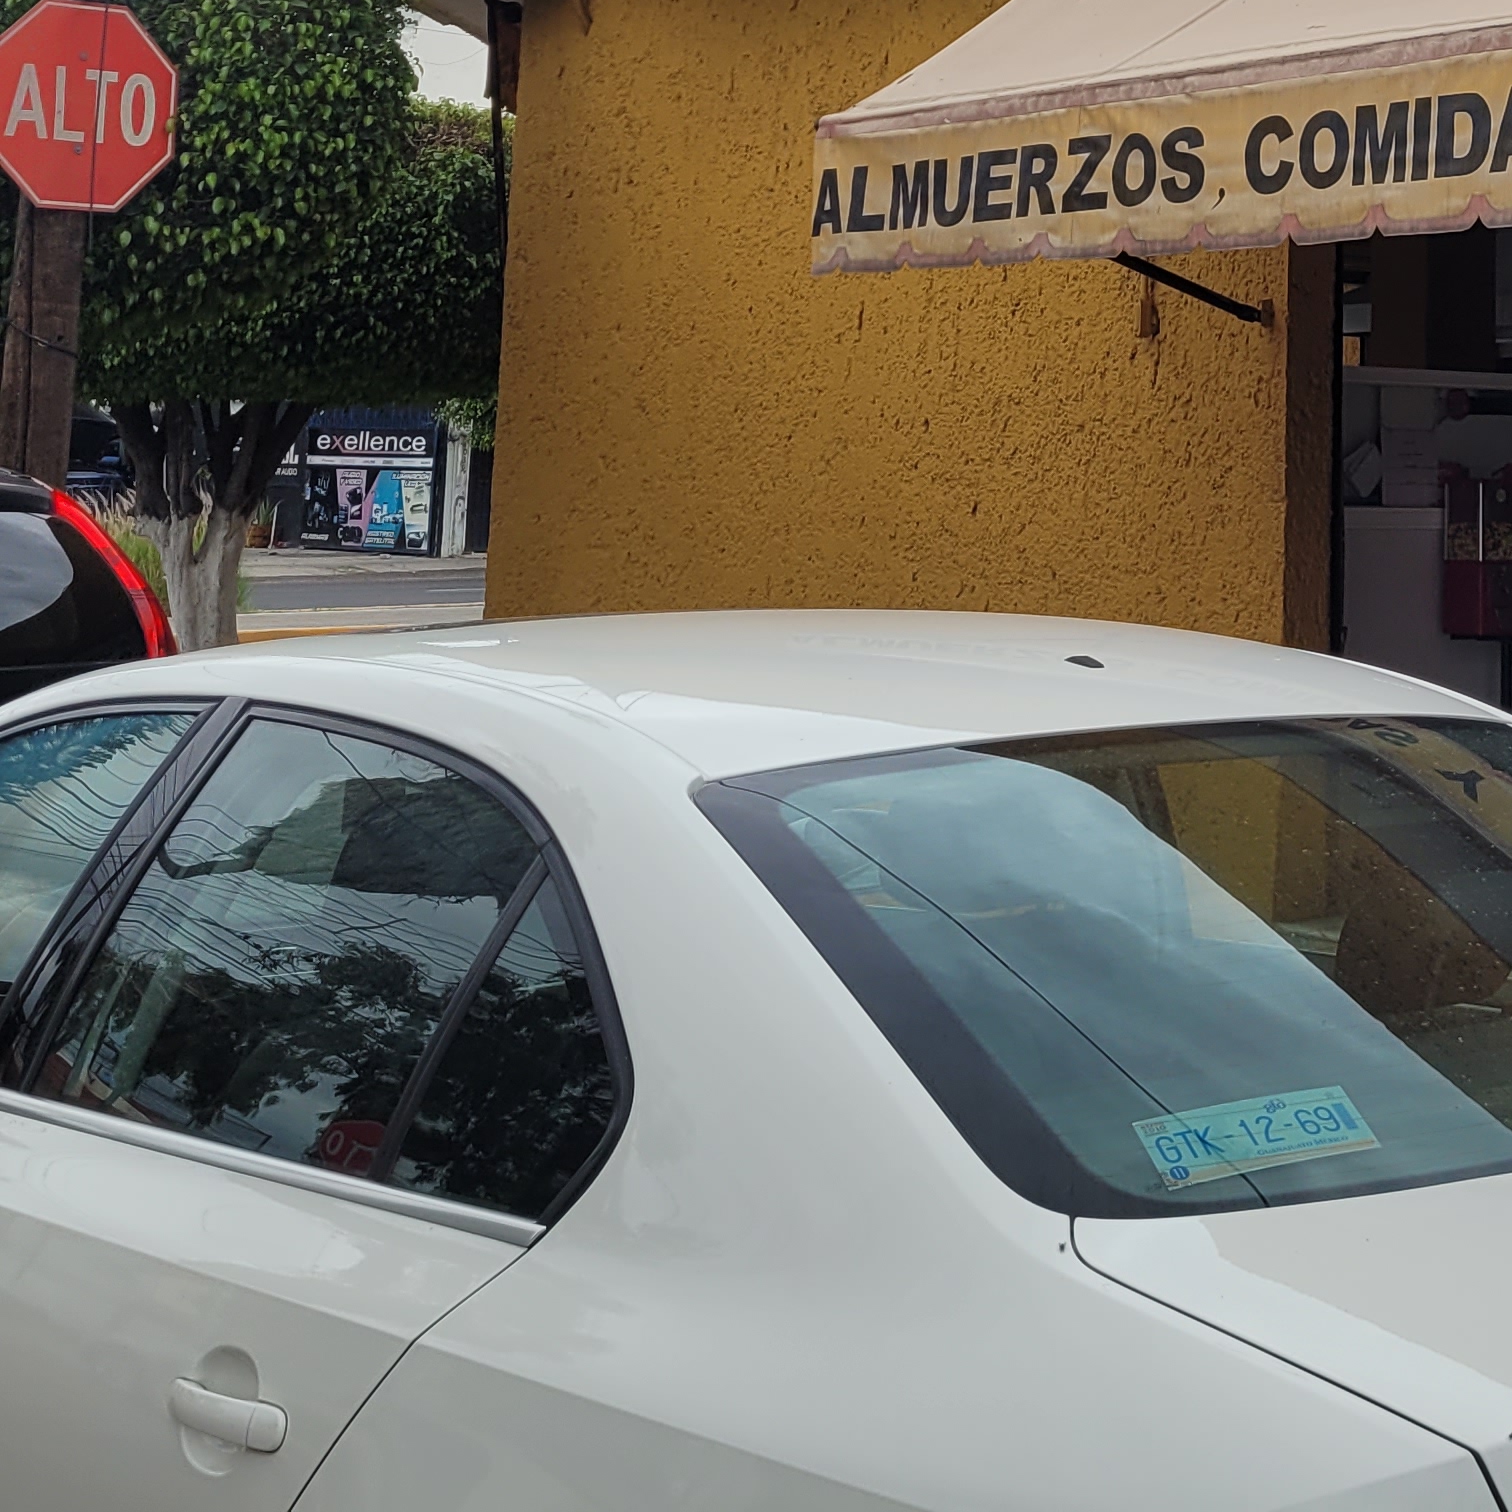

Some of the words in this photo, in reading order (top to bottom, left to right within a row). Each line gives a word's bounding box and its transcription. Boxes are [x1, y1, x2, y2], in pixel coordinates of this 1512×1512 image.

[3, 63, 156, 147] ALTO
[811, 126, 1226, 238] ALMUERZOS,
[316, 431, 427, 454] exellence
[1154, 1105, 1342, 1165] GTK-12-69
